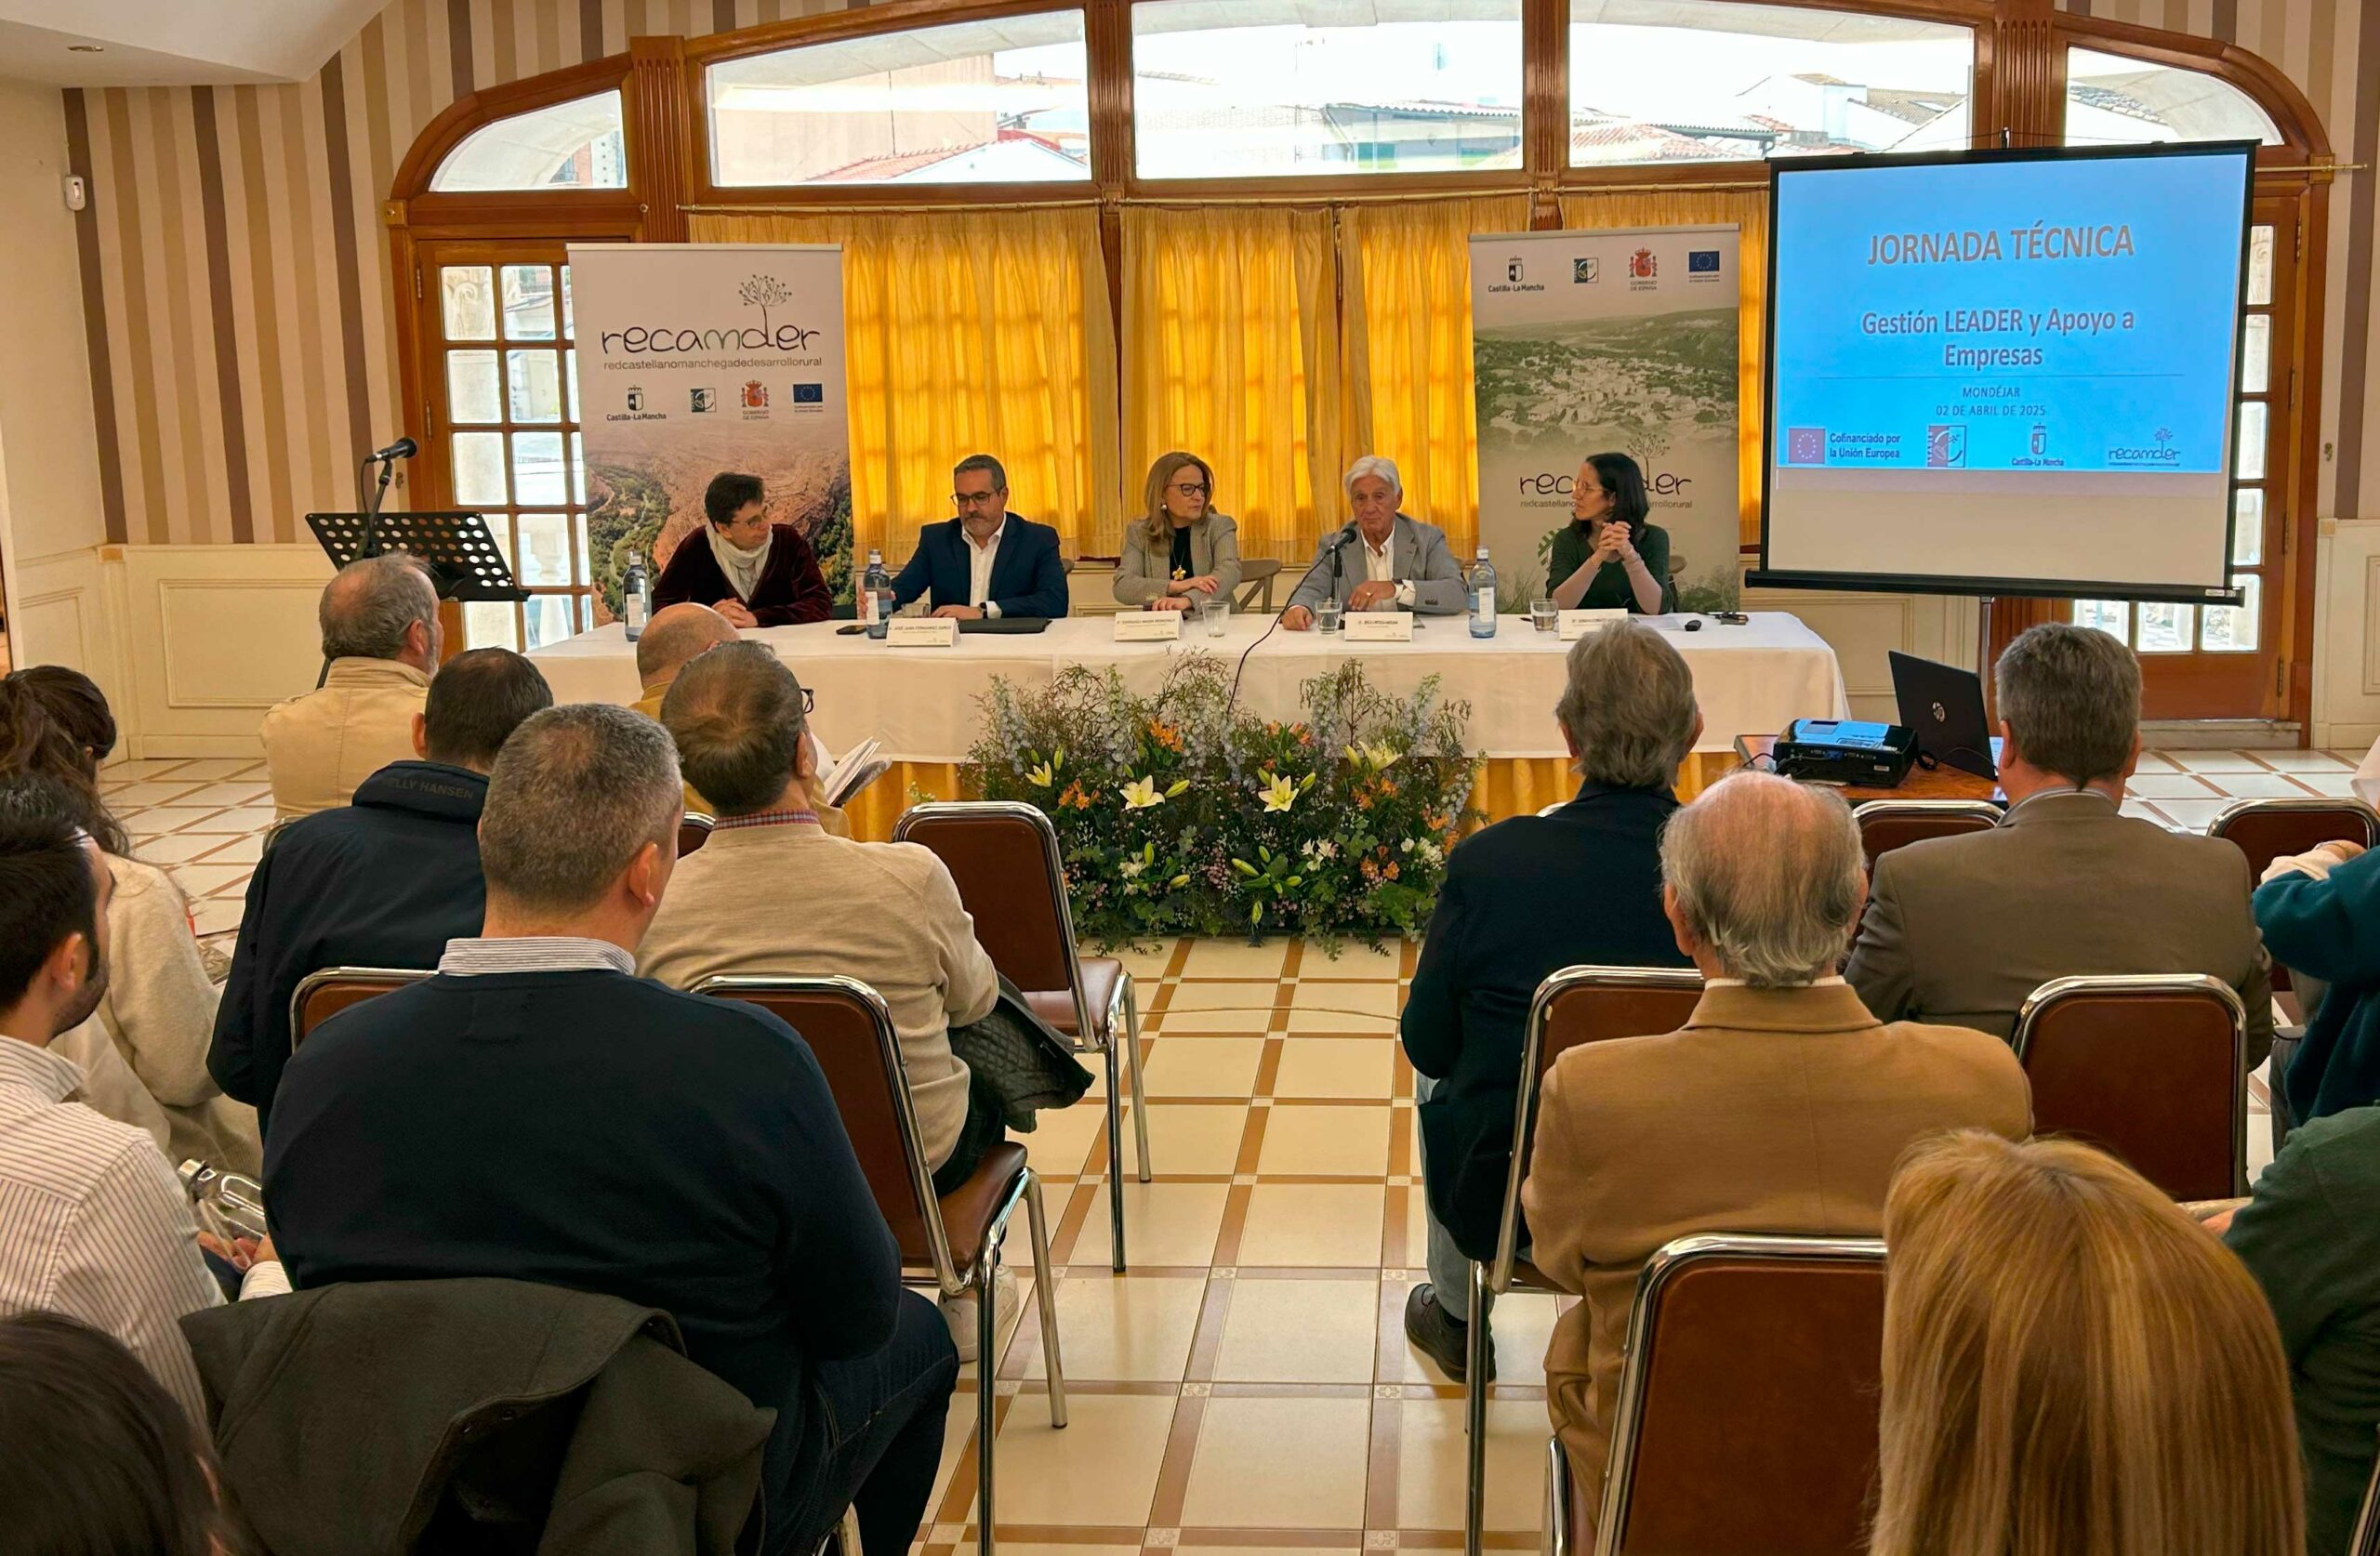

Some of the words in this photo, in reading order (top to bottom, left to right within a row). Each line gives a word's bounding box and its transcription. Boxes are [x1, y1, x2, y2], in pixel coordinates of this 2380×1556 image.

[1868, 230, 2002, 266] JORNADA
[2010, 218, 2135, 260] TÉCNICA
[1862, 310, 1938, 335] Gestión
[1945, 309, 2023, 333] LEADER
[2029, 313, 2042, 336] y
[2046, 309, 2116, 336] Apoyo
[2122, 311, 2135, 329] a
[602, 321, 821, 355] recamder
[603, 357, 822, 370] redcastellanomanchegadedesarrollorural
[1945, 344, 2043, 372] Empresas
[1962, 385, 2021, 398] MONDÉJAR
[1936, 405, 1949, 415] 02
[1952, 405, 1964, 415] DE
[1969, 405, 1997, 415] ABRIL
[2003, 405, 2016, 415] DE
[2019, 404, 2046, 415] 2025
[1830, 432, 1884, 443] Cofinanciado
[1885, 434, 1900, 444] por
[1830, 447, 1837, 457] la
[1839, 447, 1864, 457] Unión
[1865, 447, 1900, 460] Europea
[2109, 447, 2181, 460] recamder
[419, 782, 474, 799] HANSEN
